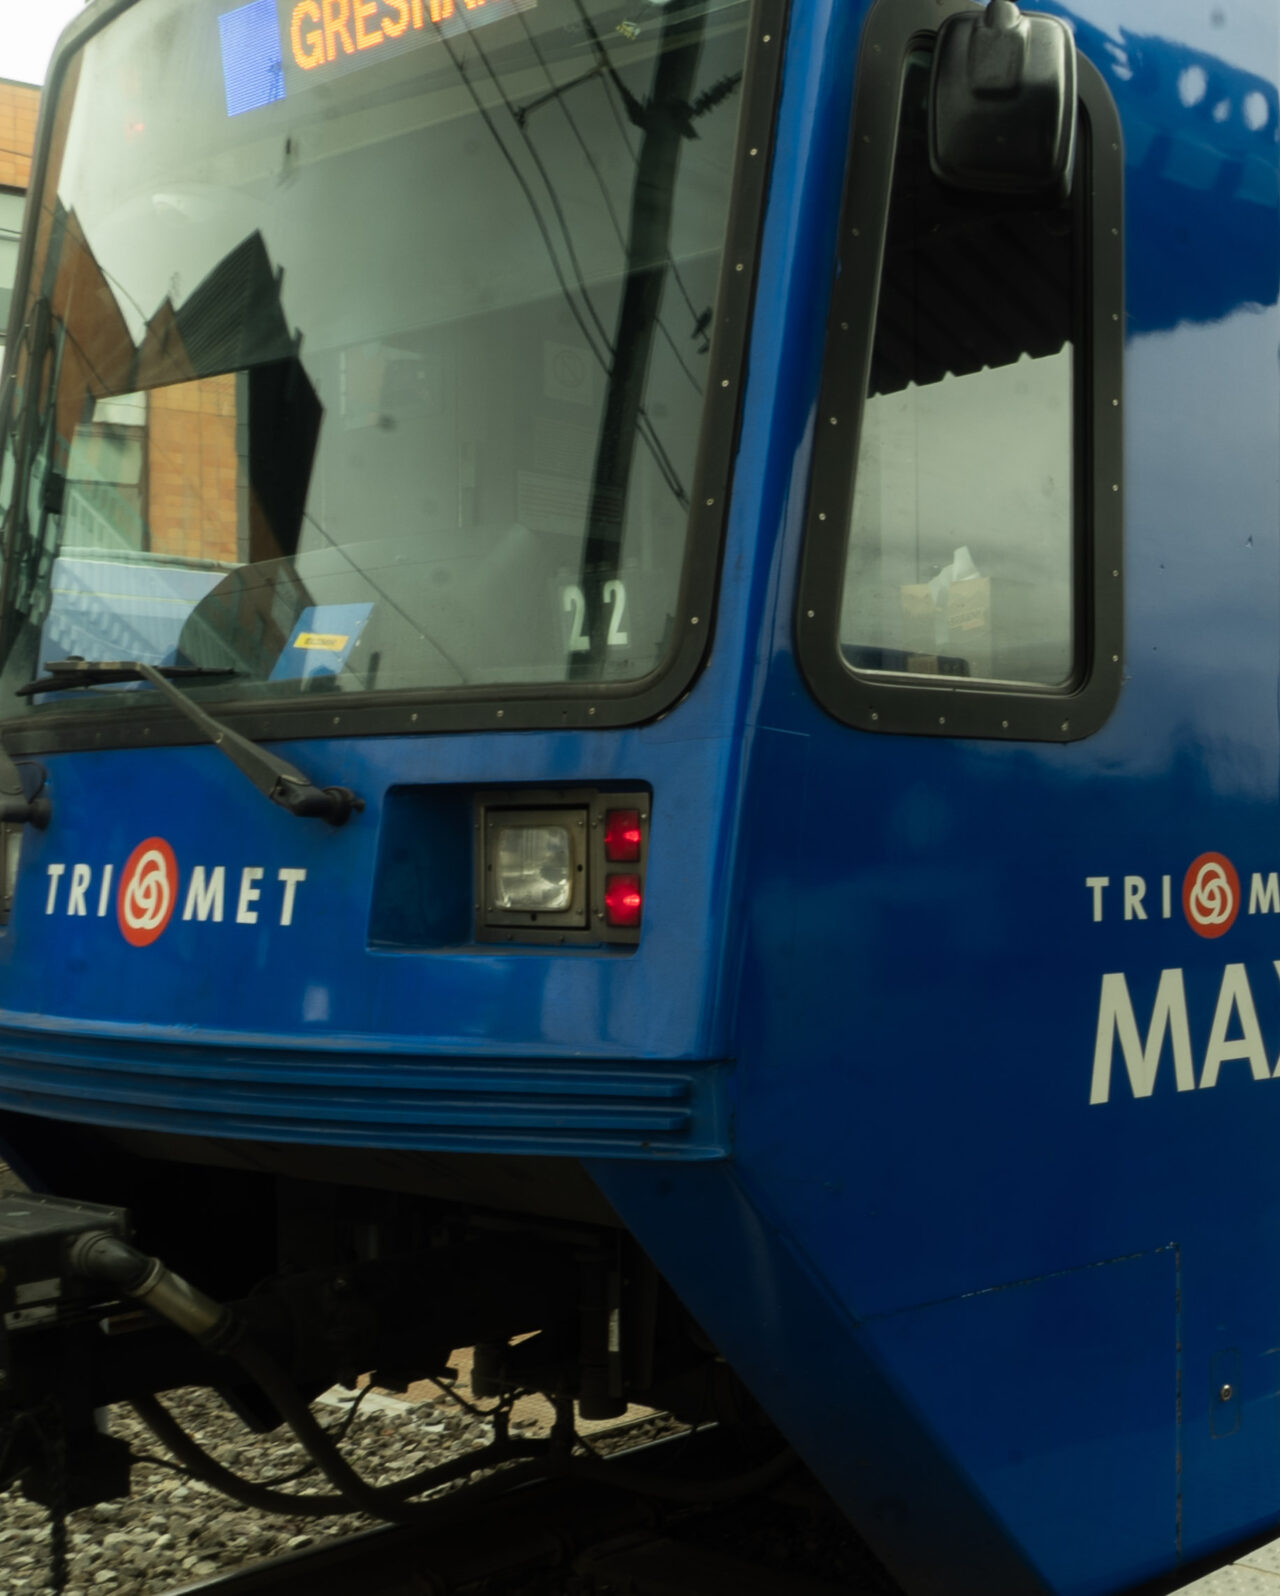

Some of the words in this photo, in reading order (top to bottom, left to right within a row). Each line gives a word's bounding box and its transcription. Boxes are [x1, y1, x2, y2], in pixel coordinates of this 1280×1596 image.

[45, 863, 111, 917] TRI
[182, 865, 306, 926] MET
[1085, 874, 1171, 922] TRI
